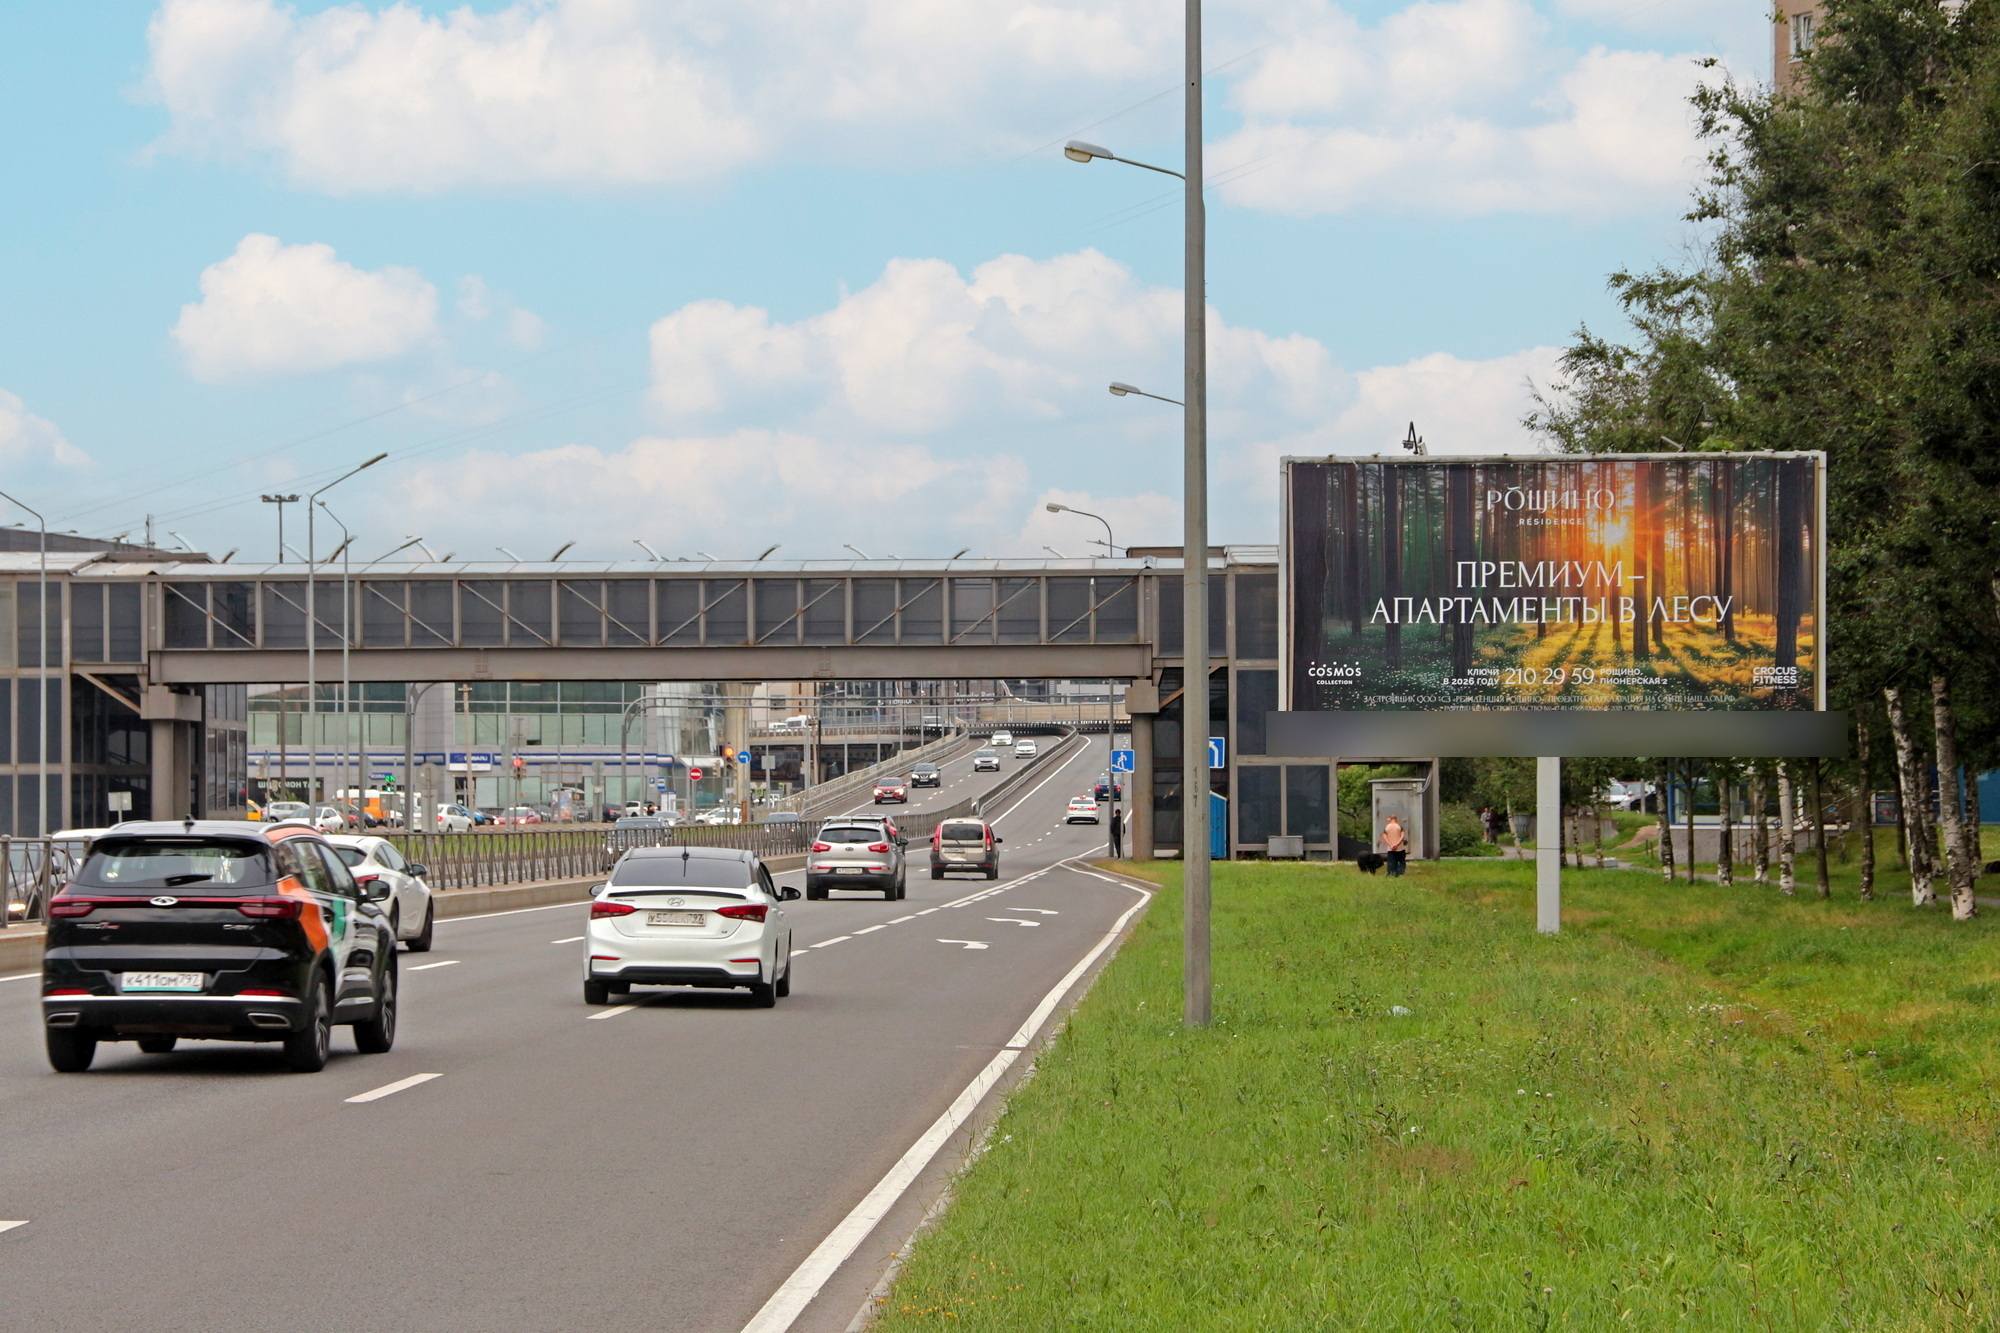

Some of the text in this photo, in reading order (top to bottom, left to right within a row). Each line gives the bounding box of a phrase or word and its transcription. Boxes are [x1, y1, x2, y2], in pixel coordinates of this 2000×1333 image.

[1487, 486, 1615, 513] РОЩИНО
[1519, 518, 1582, 526] RESIDENCE
[1370, 596, 1733, 624] АПАРТАМЕНТЫ В ЛЕСУ
[1308, 664, 1362, 677] COSMOS
[1467, 668, 1500, 676] КЛЮЧИ
[1600, 668, 1643, 676] РОЩИНО,
[1752, 666, 1797, 675] CROCUS
[1505, 667, 1595, 685] 210 29 59
[1752, 675, 1797, 684] FITNESS
[1477, 678, 1500, 686] ГОДУ
[1600, 677, 1661, 685] ПИОНЕРСКАЯ
